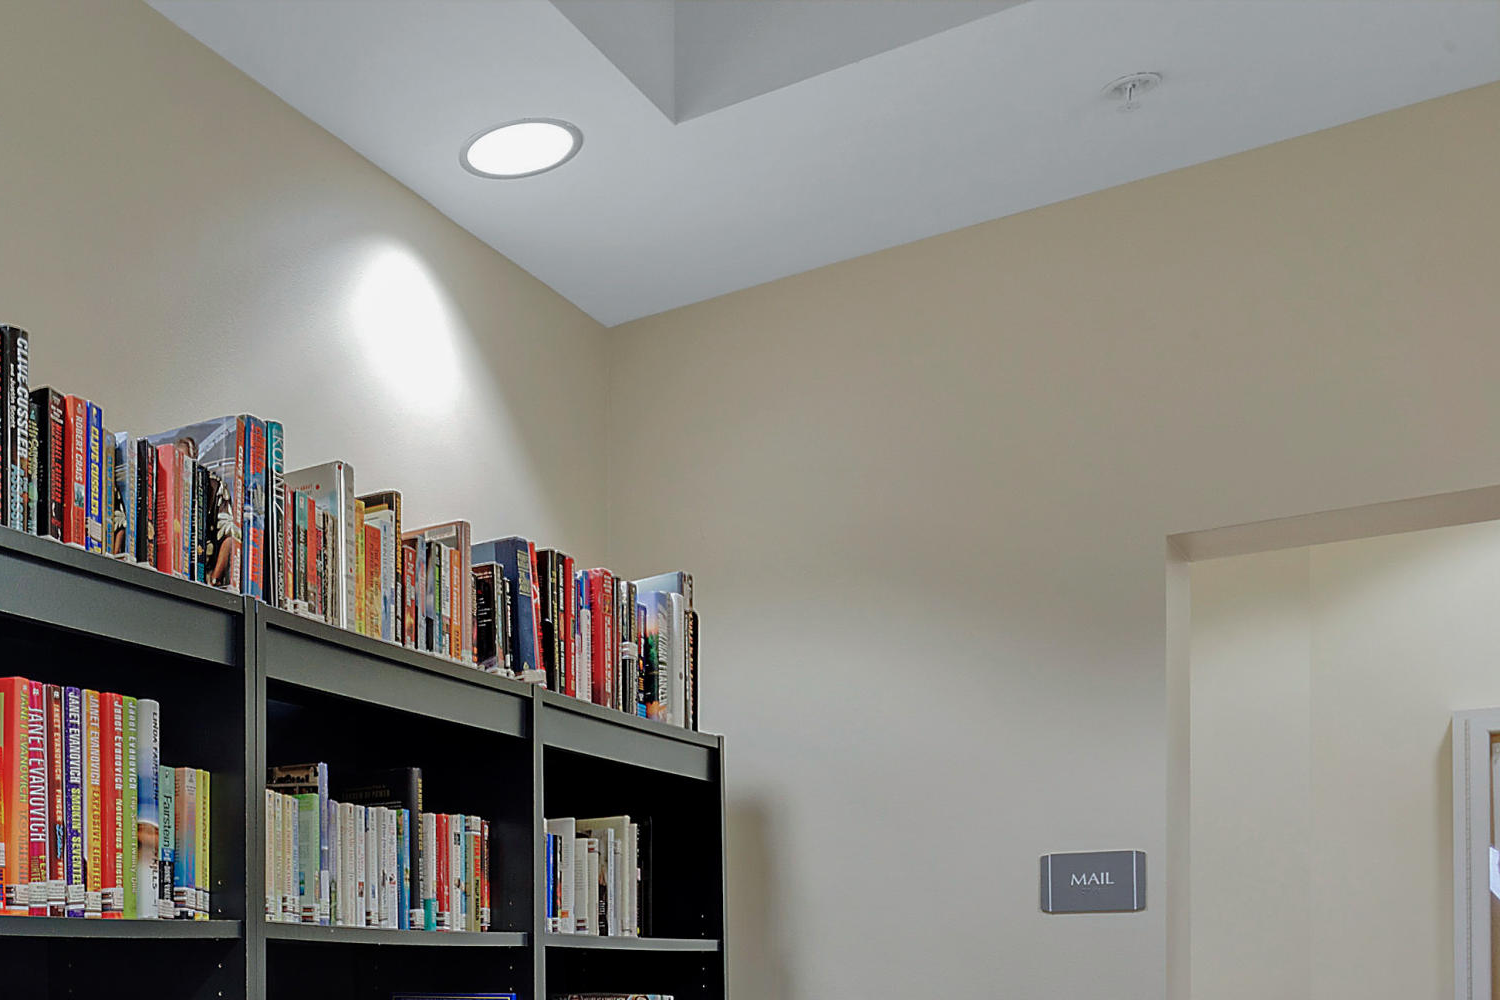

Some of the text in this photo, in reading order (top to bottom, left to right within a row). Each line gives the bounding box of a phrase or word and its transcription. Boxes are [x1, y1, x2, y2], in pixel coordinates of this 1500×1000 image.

[29, 707, 46, 843] JANET EVANOVICH
[1071, 872, 1115, 886] MAIL
